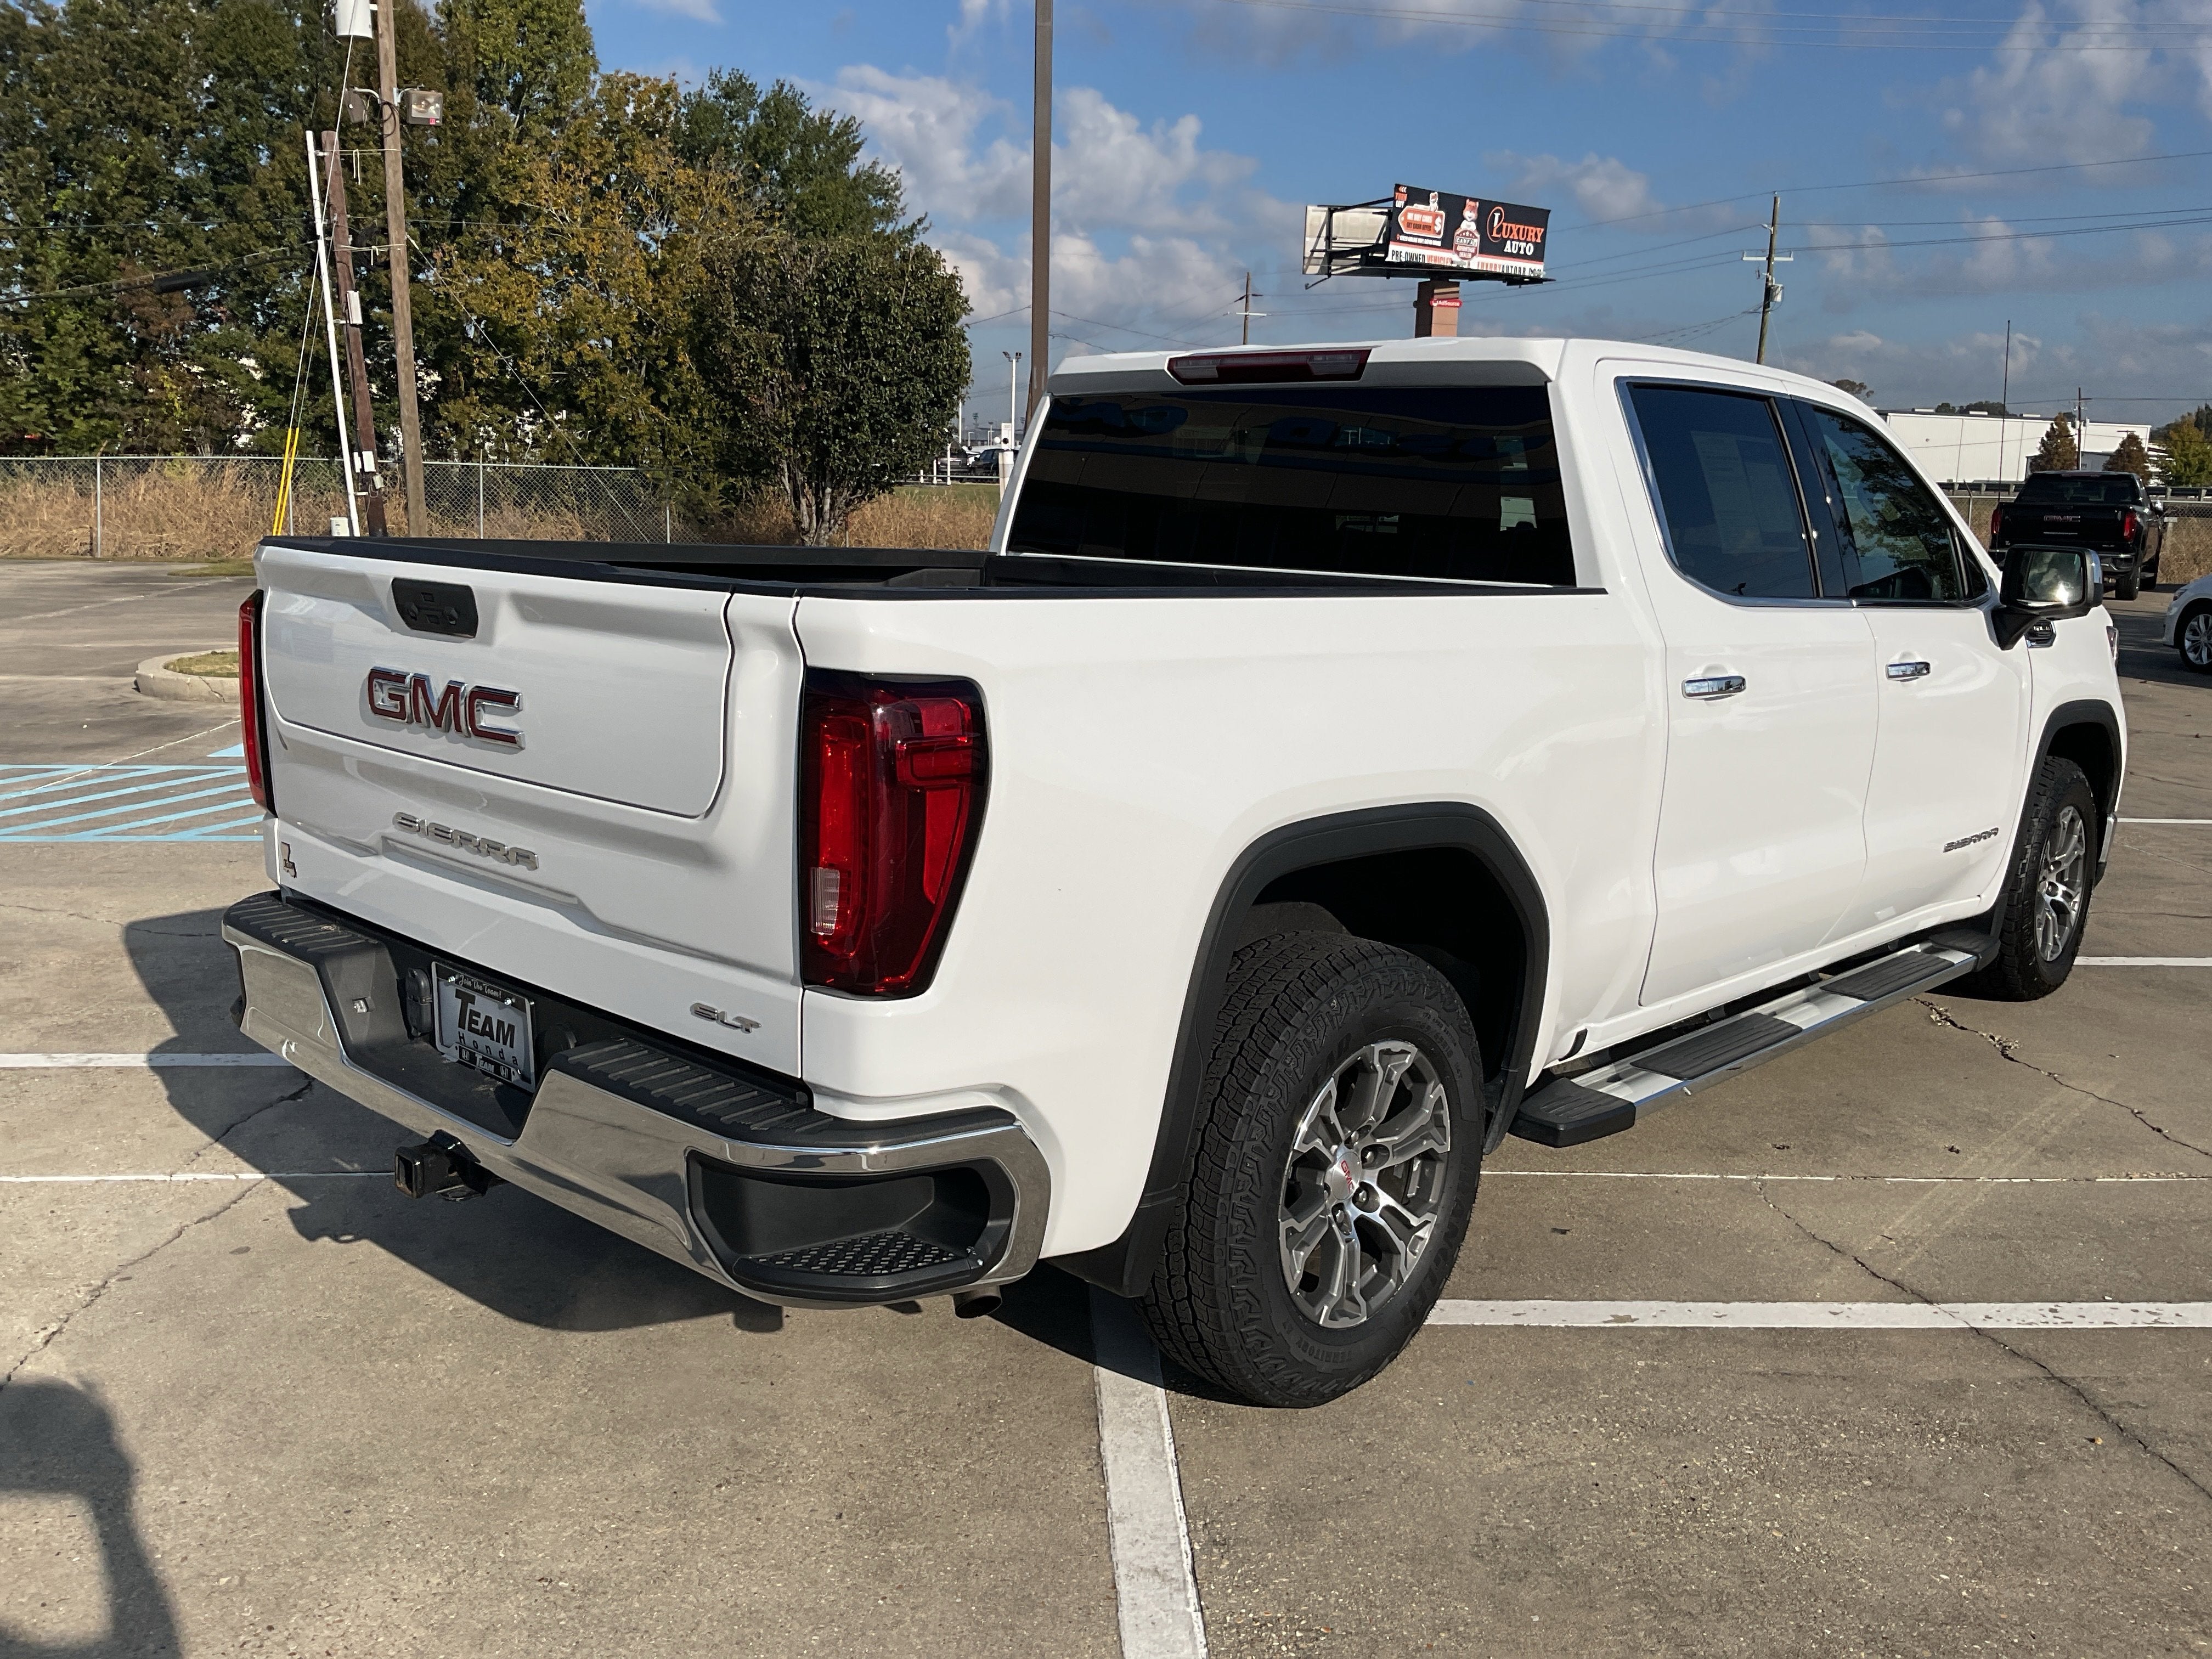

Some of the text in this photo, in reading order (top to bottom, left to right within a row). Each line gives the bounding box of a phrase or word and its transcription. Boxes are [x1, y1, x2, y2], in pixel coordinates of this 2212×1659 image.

[1456, 237, 1477, 246] CARFAX
[1489, 211, 1544, 242] LUXURY
[1391, 250, 1426, 263] PRE-OWNED
[1504, 240, 1534, 256] AUTO
[368, 665, 526, 749] GMC
[392, 812, 539, 871] SIERRA
[1943, 827, 1999, 853] SIERRA
[459, 974, 472, 987] Join
[454, 989, 515, 1048] TEAM
[690, 1002, 762, 1034] SLT
[458, 1031, 518, 1066] Honda
[475, 1053, 494, 1073] TEAM
[1341, 1159, 1354, 1194] GMC
